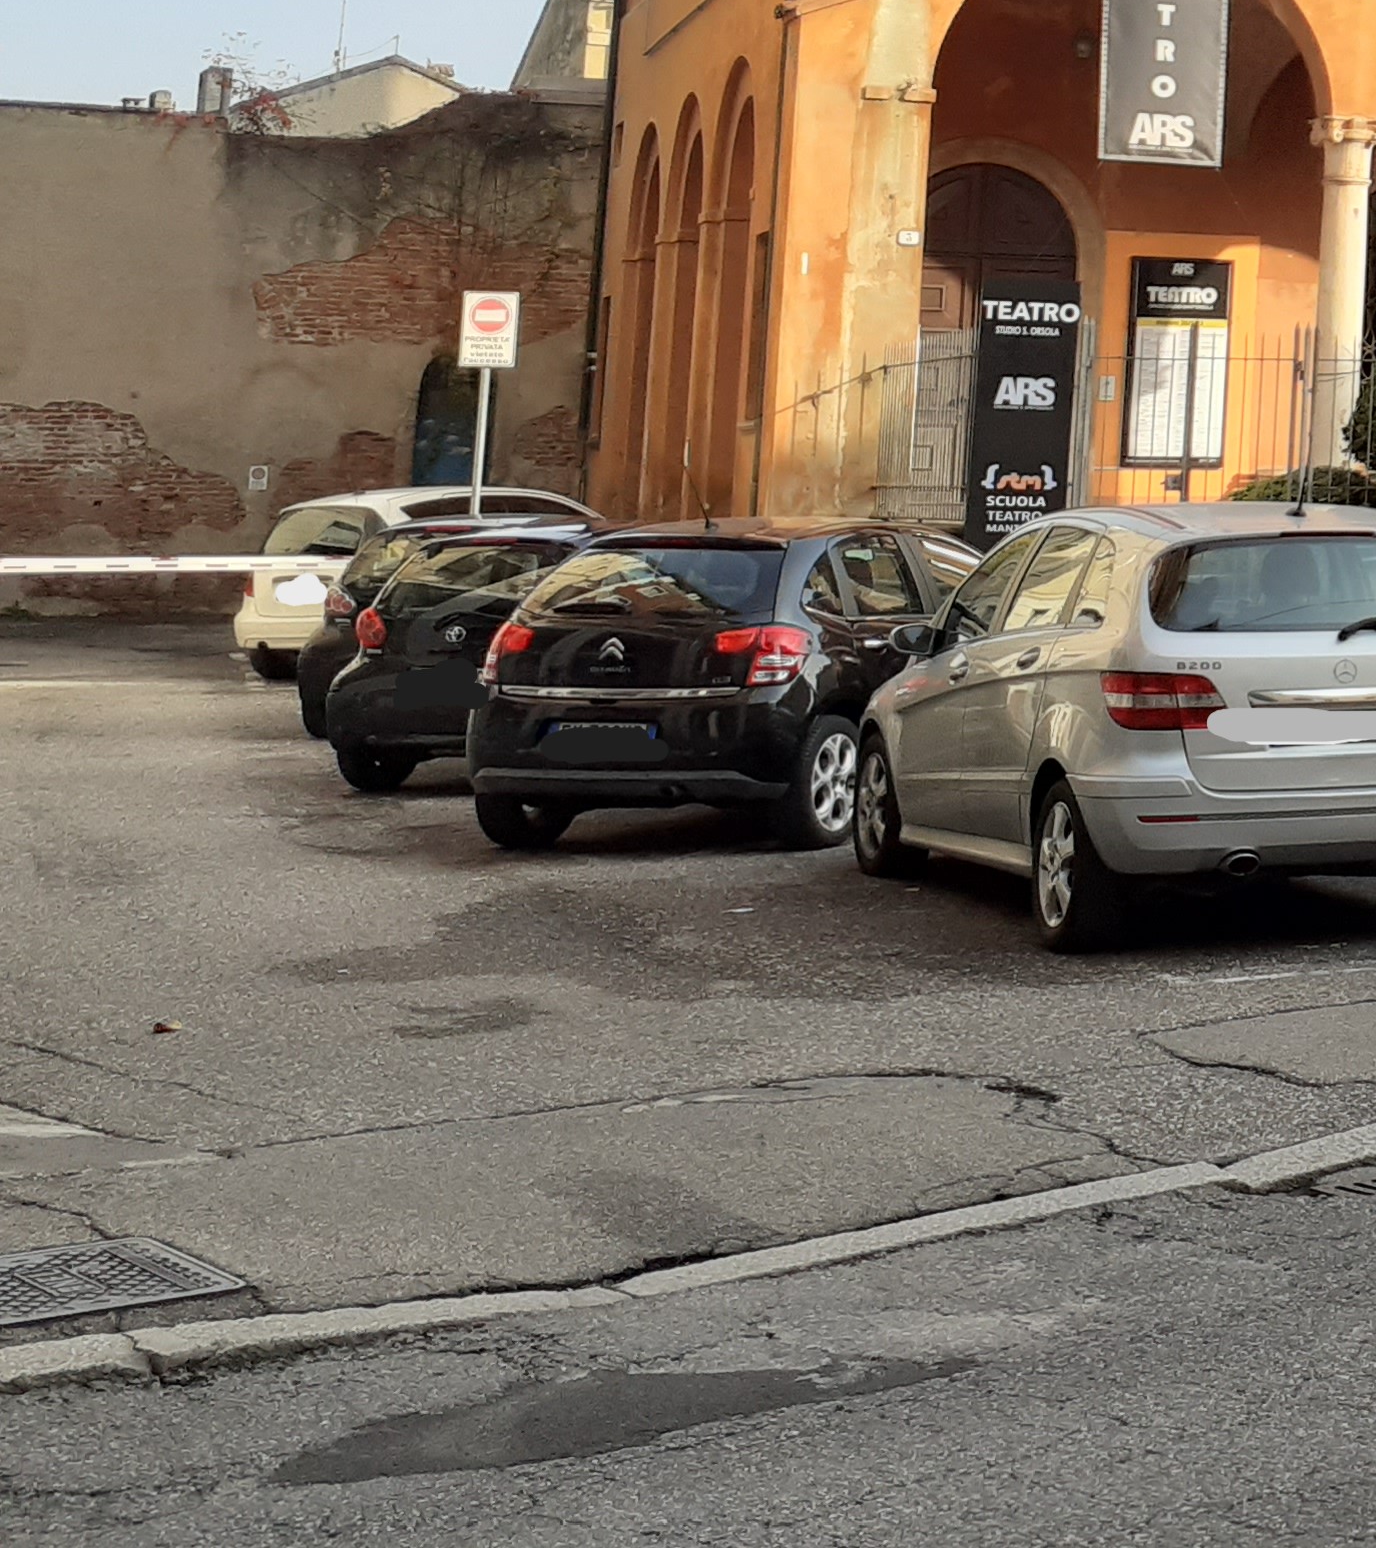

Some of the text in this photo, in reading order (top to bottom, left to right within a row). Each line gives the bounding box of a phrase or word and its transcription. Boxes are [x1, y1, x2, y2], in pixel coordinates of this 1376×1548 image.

[1128, 112, 1195, 148] ARS
[1171, 262, 1195, 276] ARS
[1146, 285, 1218, 304] TEATRO
[982, 300, 1080, 323] TEATRO
[994, 376, 1056, 406] ARS
[986, 496, 1046, 507] SCUOLA
[1176, 661, 1222, 670] B200
